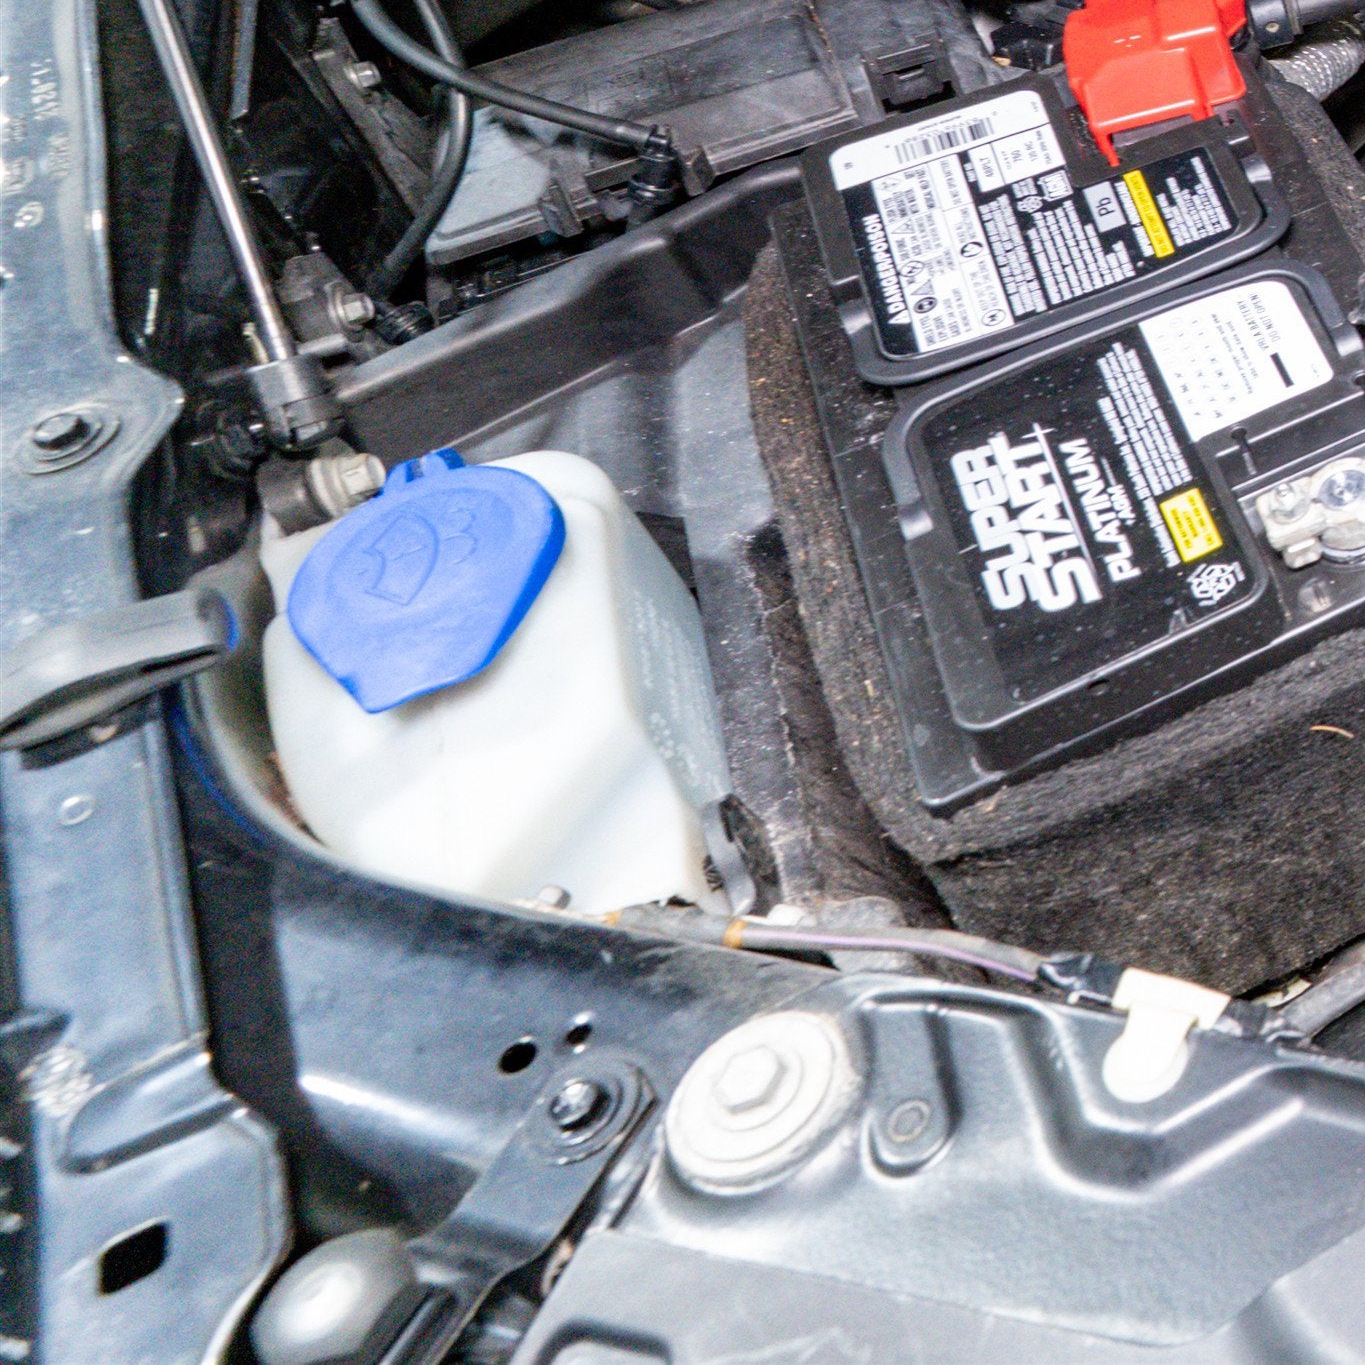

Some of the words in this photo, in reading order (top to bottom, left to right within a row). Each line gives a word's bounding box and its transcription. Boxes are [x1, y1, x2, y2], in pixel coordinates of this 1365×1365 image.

[1096, 197, 1114, 216] Pb
[862, 213, 908, 313] DANGER/POISON
[1237, 300, 1258, 330] BATTERY
[1260, 315, 1273, 330] NOT
[951, 444, 1040, 610] SUPER
[987, 432, 1102, 612] START
[1058, 437, 1141, 583] PLATINUM
